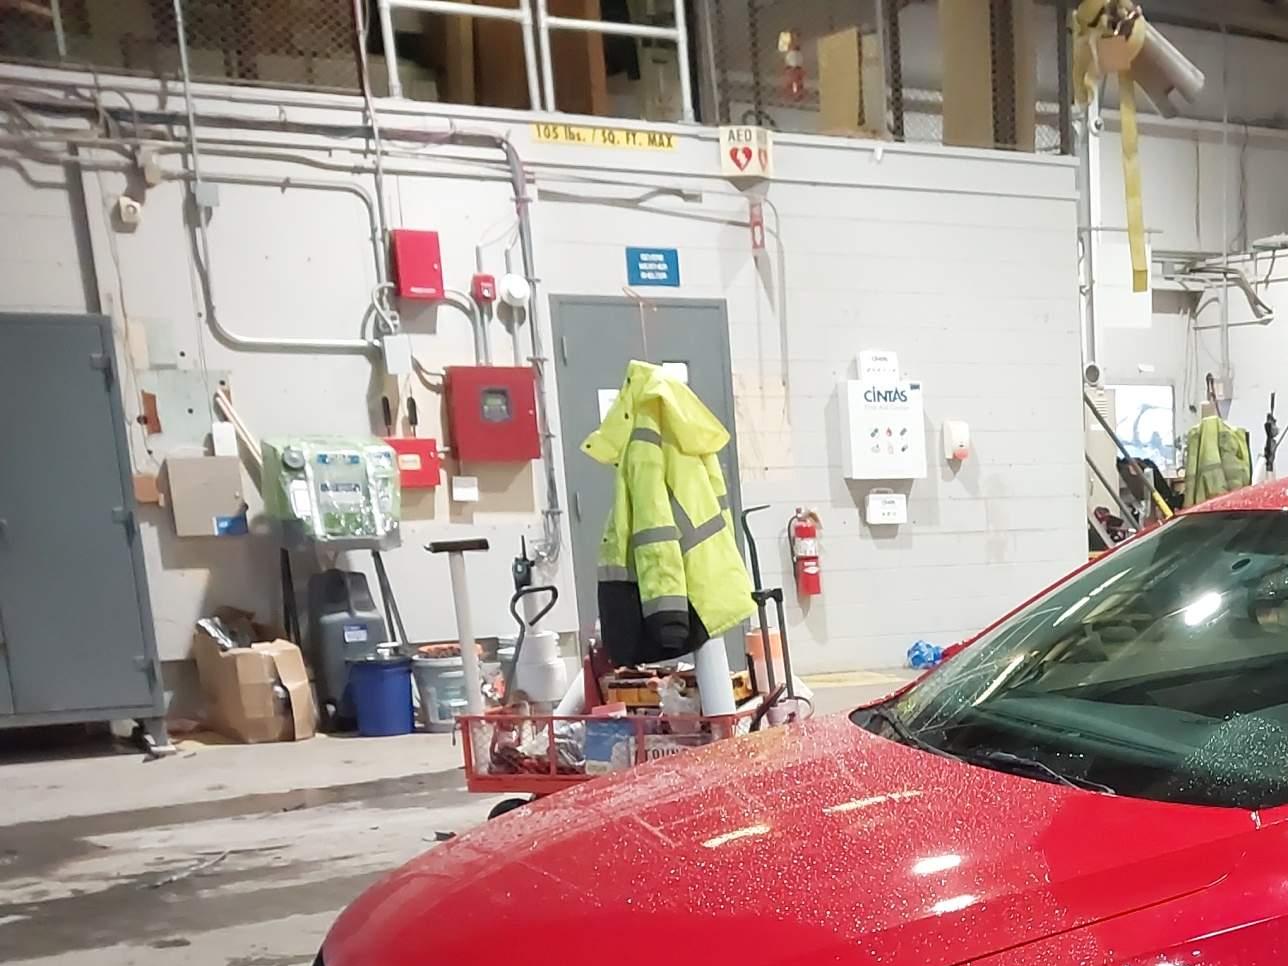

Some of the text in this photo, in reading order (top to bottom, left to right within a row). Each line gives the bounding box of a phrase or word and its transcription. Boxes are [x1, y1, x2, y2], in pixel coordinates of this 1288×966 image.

[535, 123, 559, 140] 105
[564, 125, 586, 143] lbs.
[601, 129, 620, 145] SQ.
[647, 132, 673, 149] MAX
[727, 128, 752, 143] AED
[863, 385, 908, 403] CINTAS
